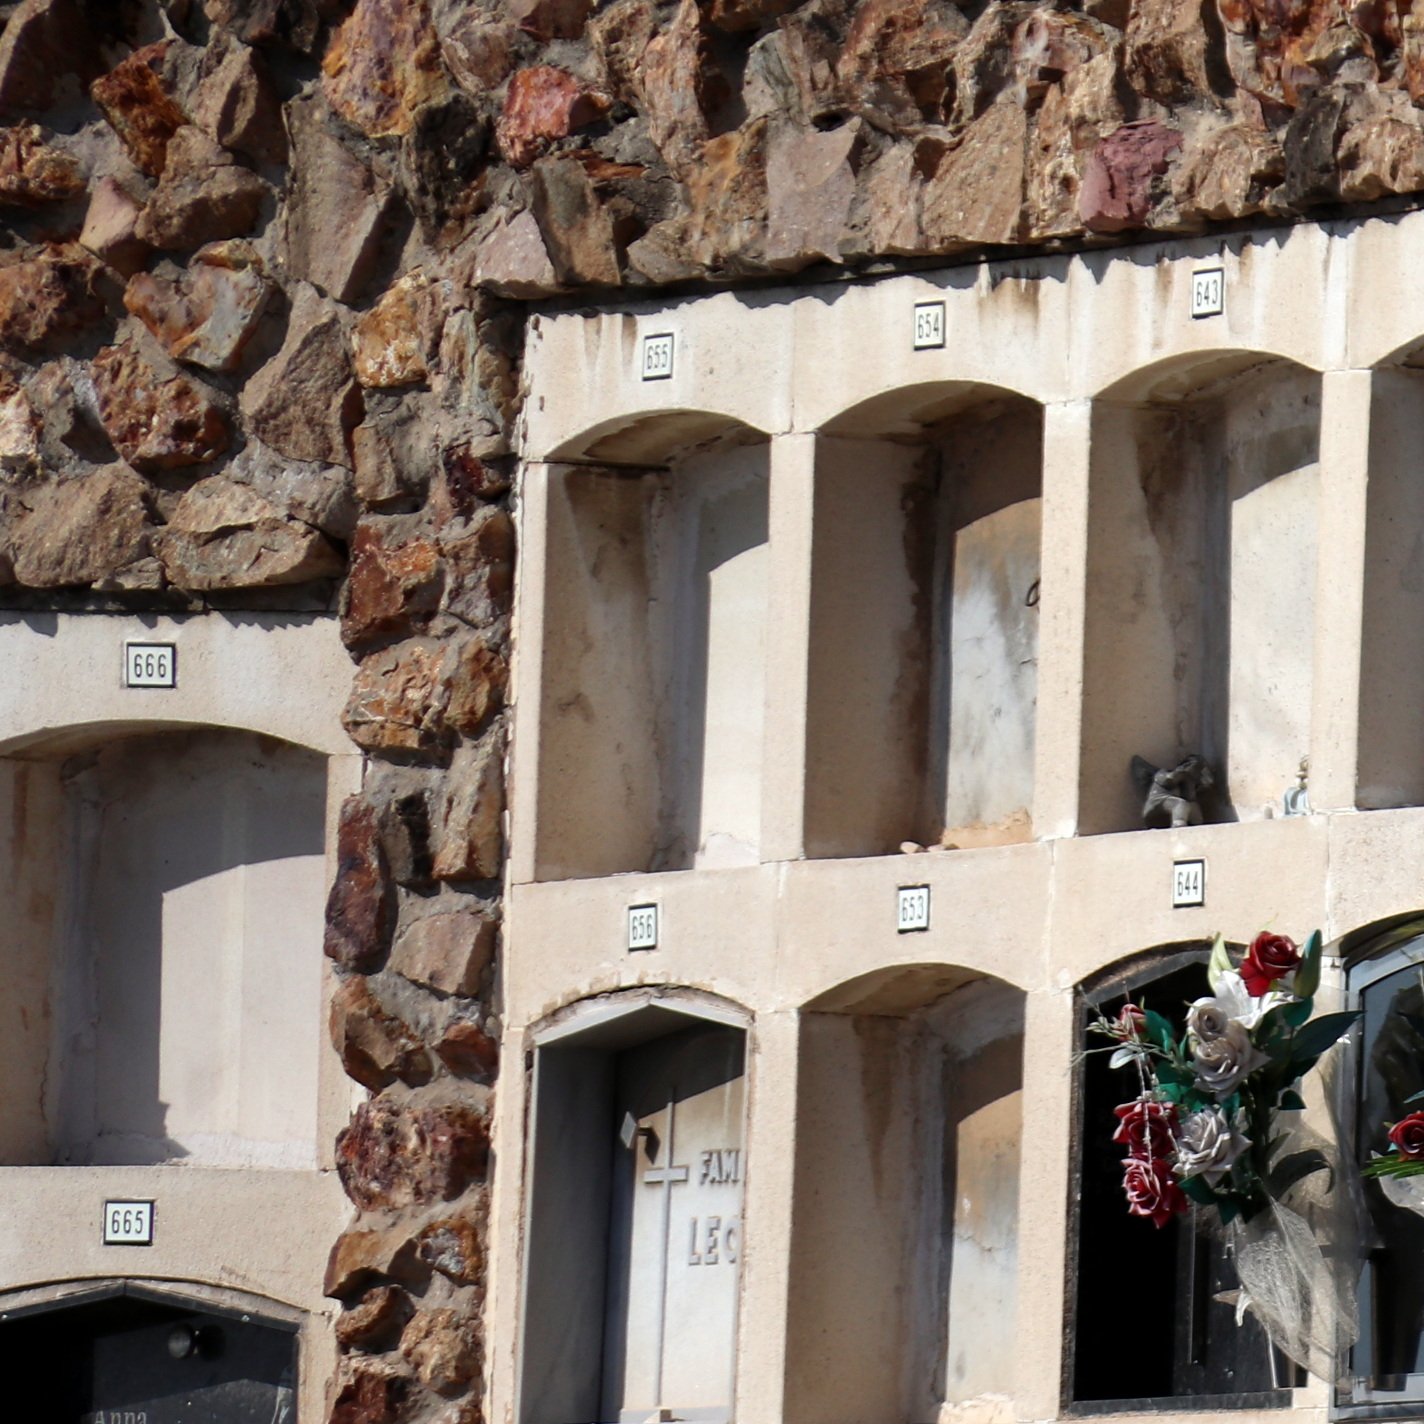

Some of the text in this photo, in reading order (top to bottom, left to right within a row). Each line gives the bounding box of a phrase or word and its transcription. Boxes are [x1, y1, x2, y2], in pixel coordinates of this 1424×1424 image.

[1195, 279, 1219, 307] 643
[917, 312, 940, 340] 654
[646, 343, 669, 370] 655
[133, 652, 167, 678] 666
[1177, 870, 1199, 897] 644
[901, 895, 924, 923] 653
[631, 914, 653, 941] 656
[111, 1209, 145, 1235] 665
